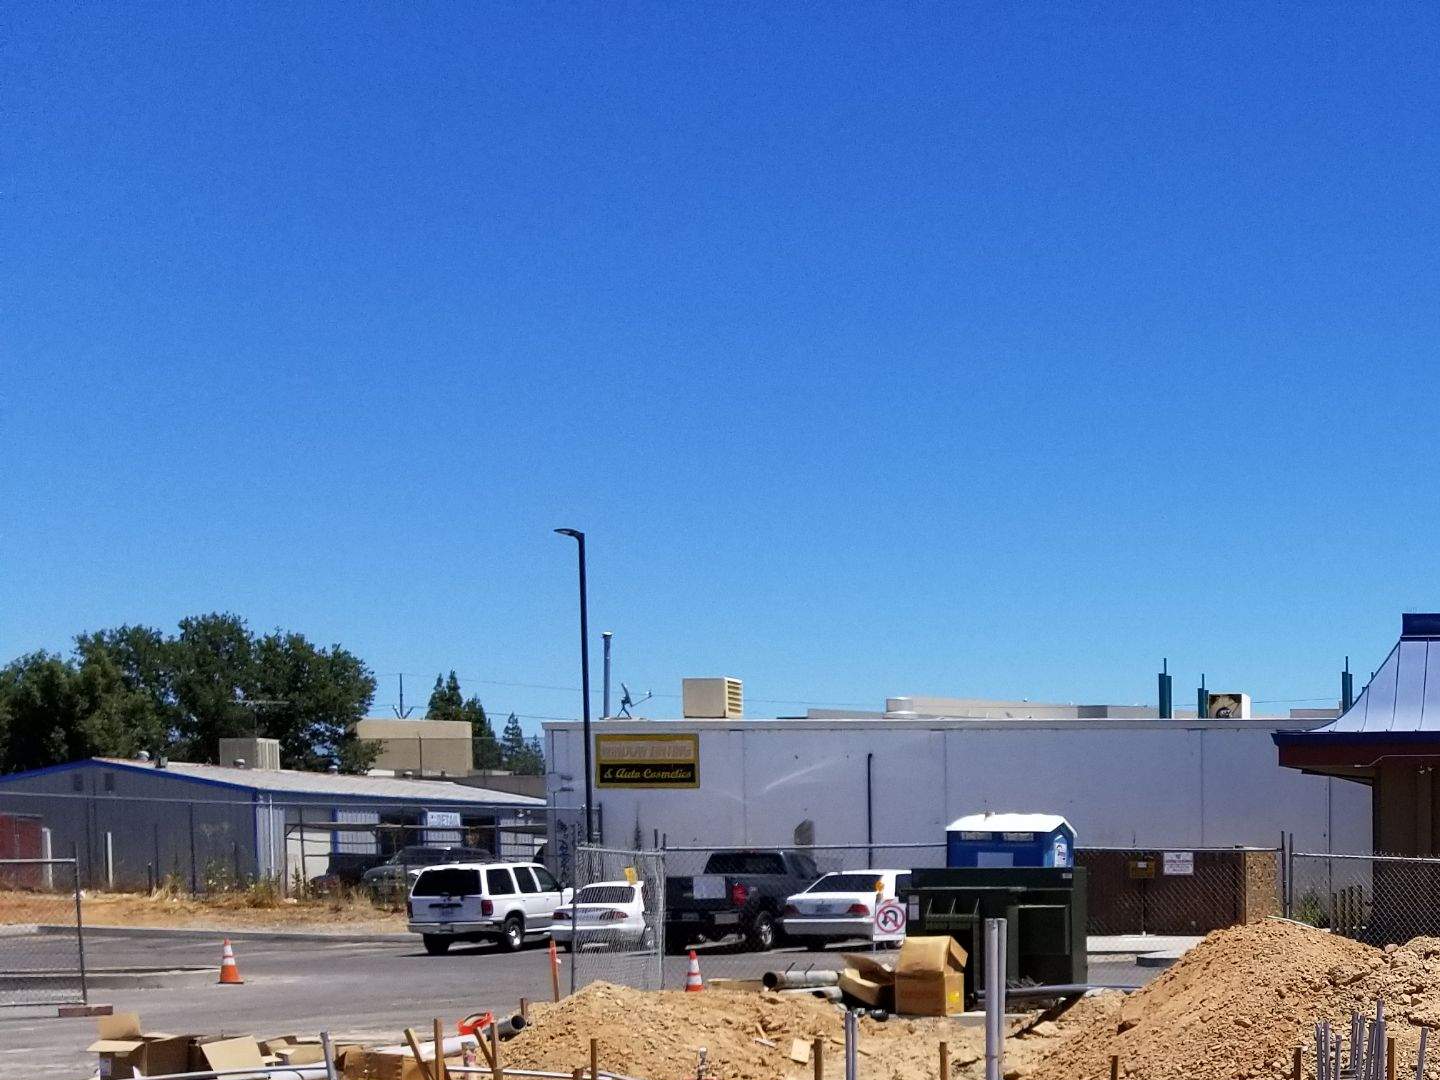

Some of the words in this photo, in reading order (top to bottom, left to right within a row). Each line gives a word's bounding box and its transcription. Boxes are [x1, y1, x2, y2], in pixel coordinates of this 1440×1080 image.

[604, 768, 613, 778] &
[616, 767, 640, 779] Auto
[643, 767, 692, 779] Cosmetics
